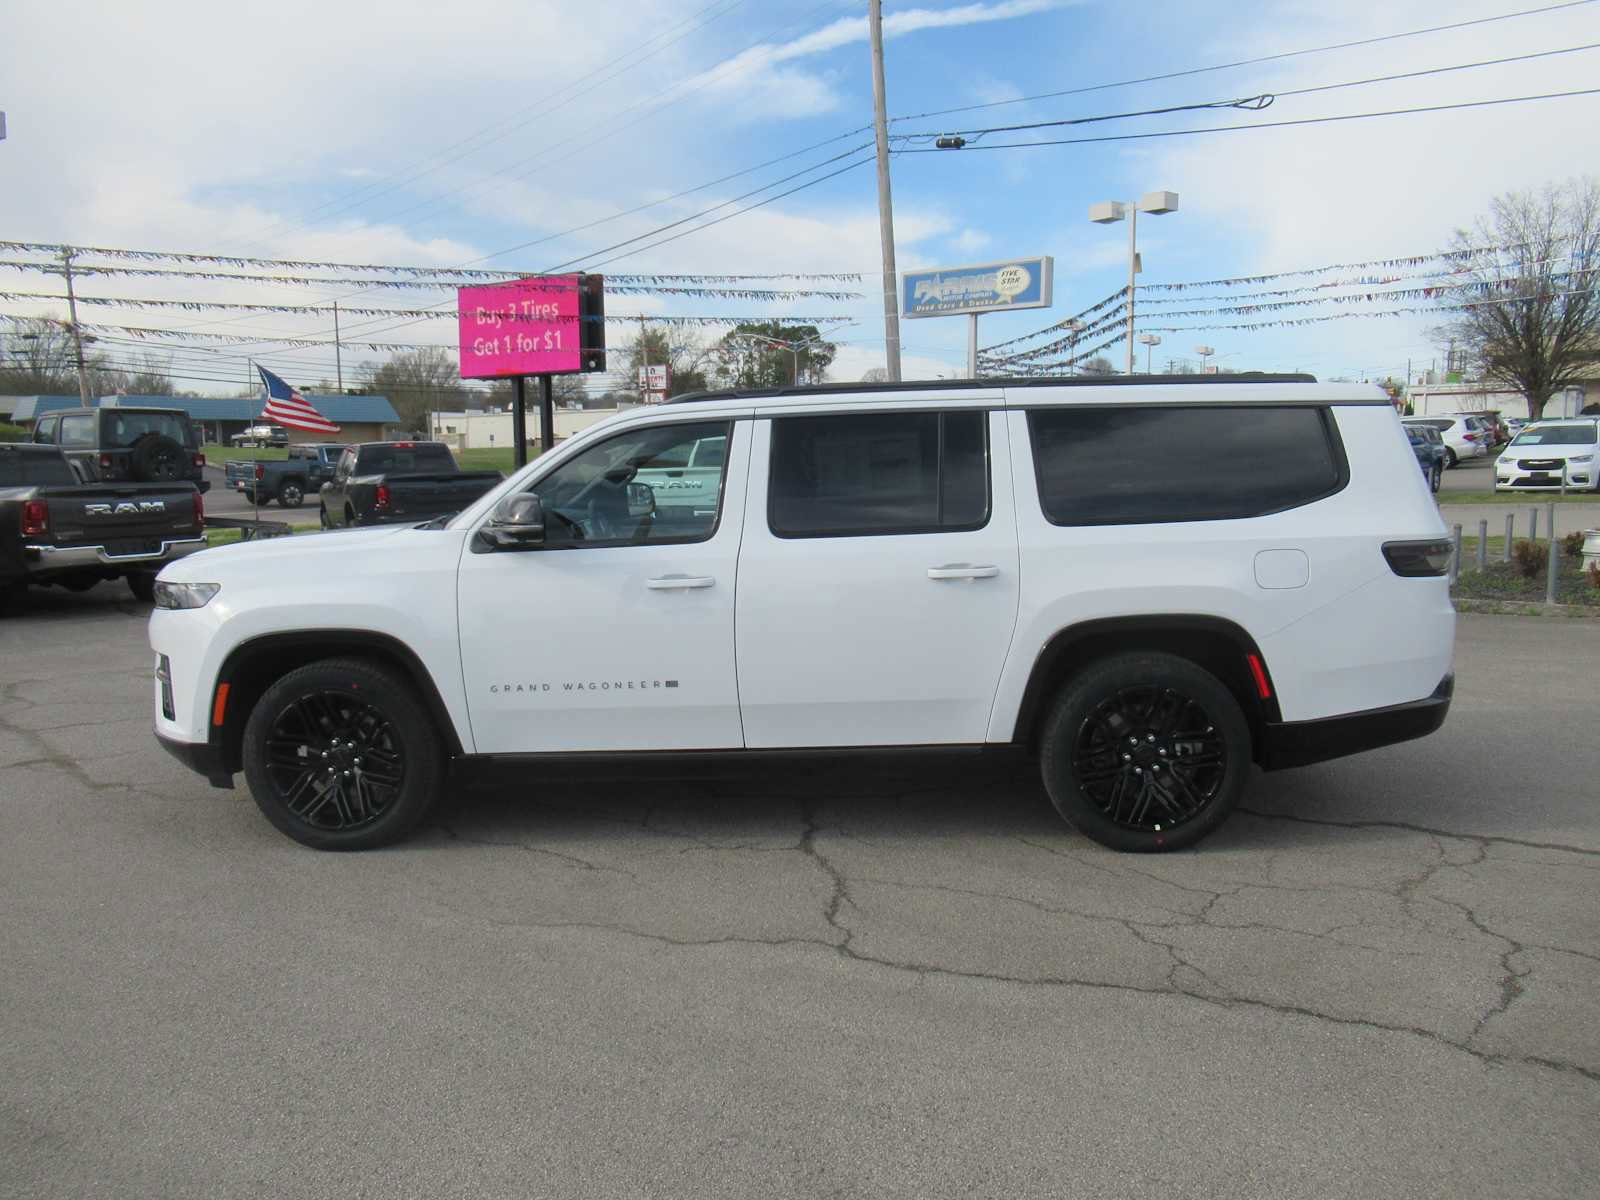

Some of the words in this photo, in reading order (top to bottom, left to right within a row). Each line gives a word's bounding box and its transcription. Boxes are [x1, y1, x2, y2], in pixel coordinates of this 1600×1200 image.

[1000, 277, 1021, 285] STAR
[476, 306, 504, 329] Buy
[508, 303, 517, 321] 3
[521, 299, 559, 319] Tires
[474, 337, 500, 356] Get
[503, 335, 511, 353] 1
[516, 332, 540, 352] for
[544, 329, 562, 352] $1
[650, 480, 702, 489] RAM
[84, 501, 165, 515] RAM
[490, 683, 551, 693] GRAND
[563, 680, 661, 691] WAGONEER
